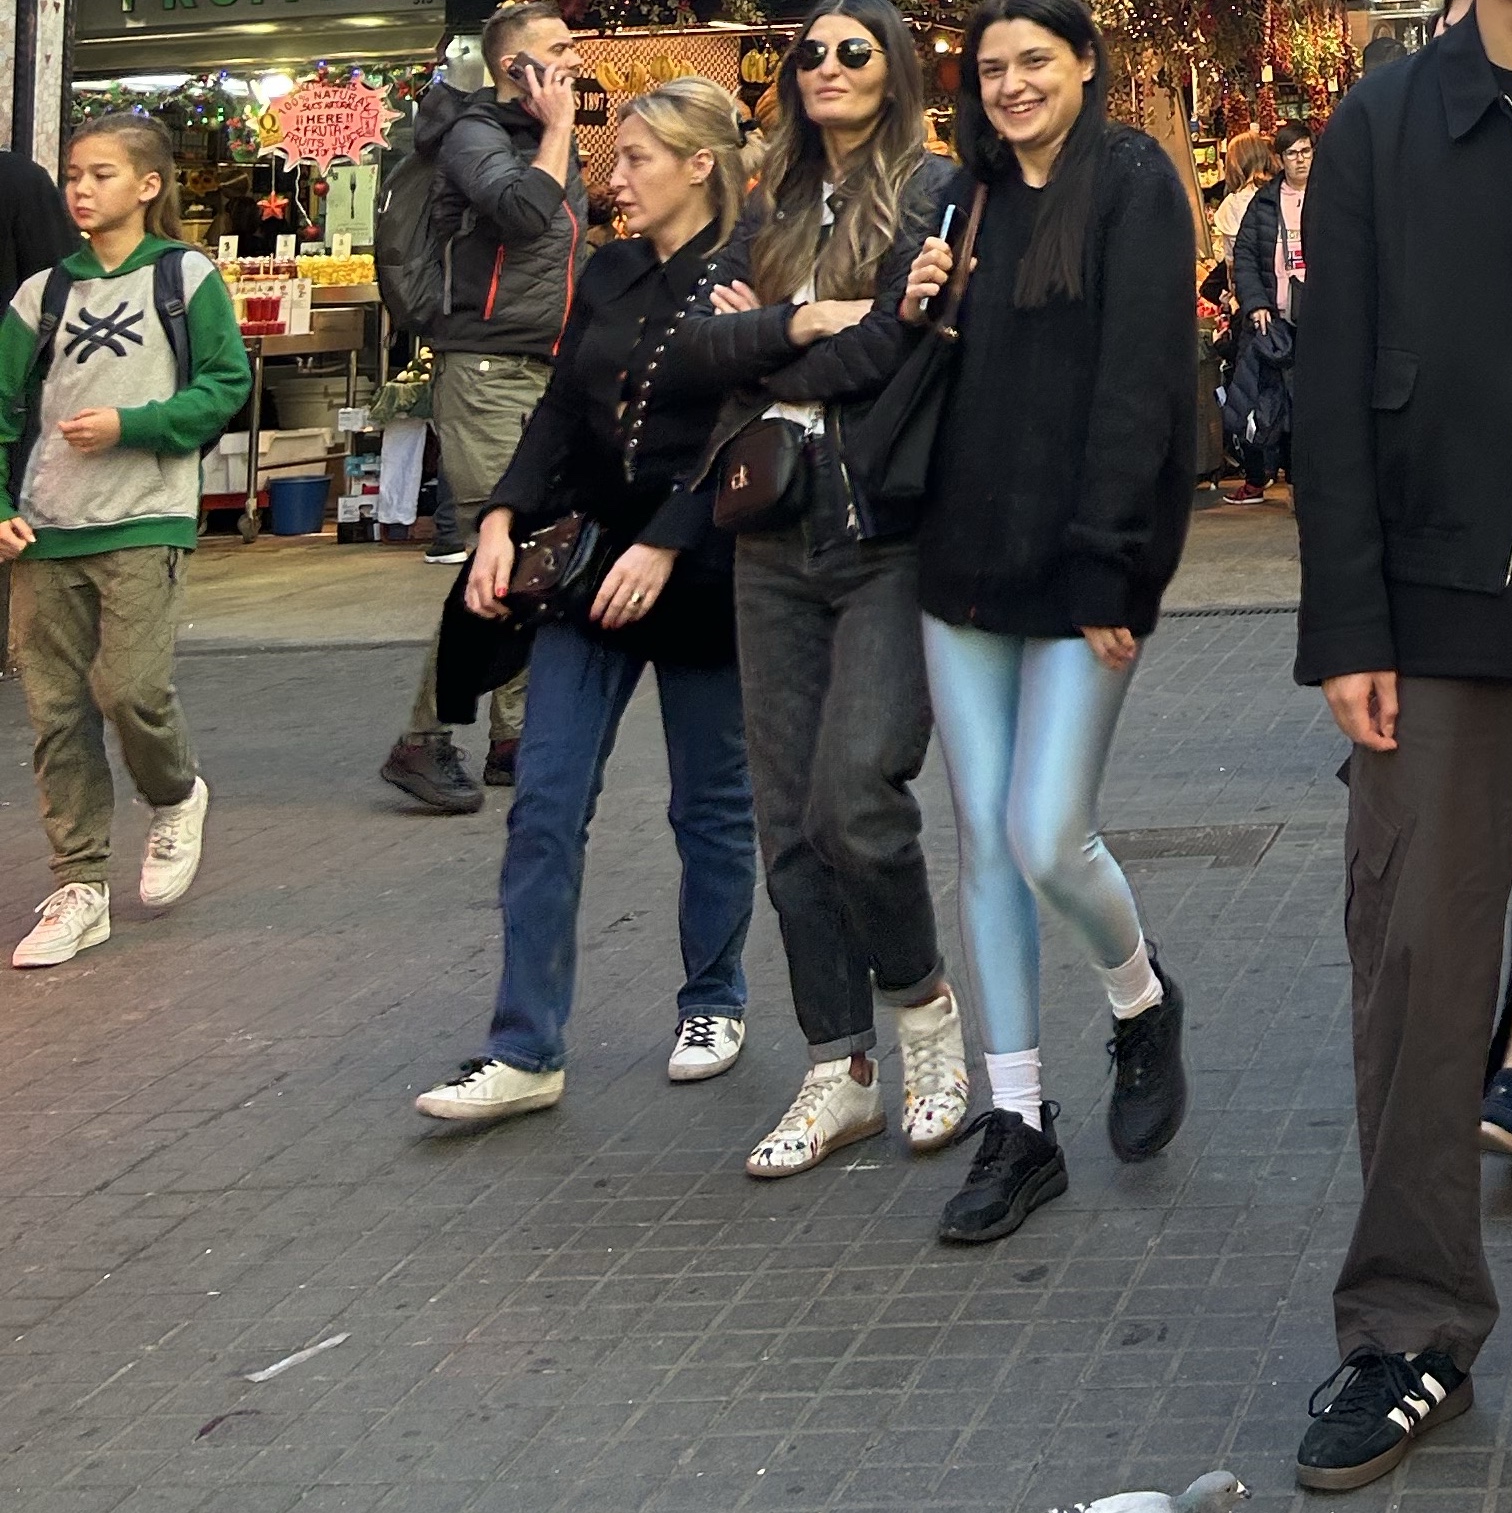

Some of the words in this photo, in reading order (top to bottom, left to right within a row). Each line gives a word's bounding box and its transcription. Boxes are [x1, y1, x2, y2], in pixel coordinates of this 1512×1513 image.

[313, 89, 373, 112] NATURAL
[583, 92, 605, 111] 1897
[303, 125, 342, 138] FRUTA
